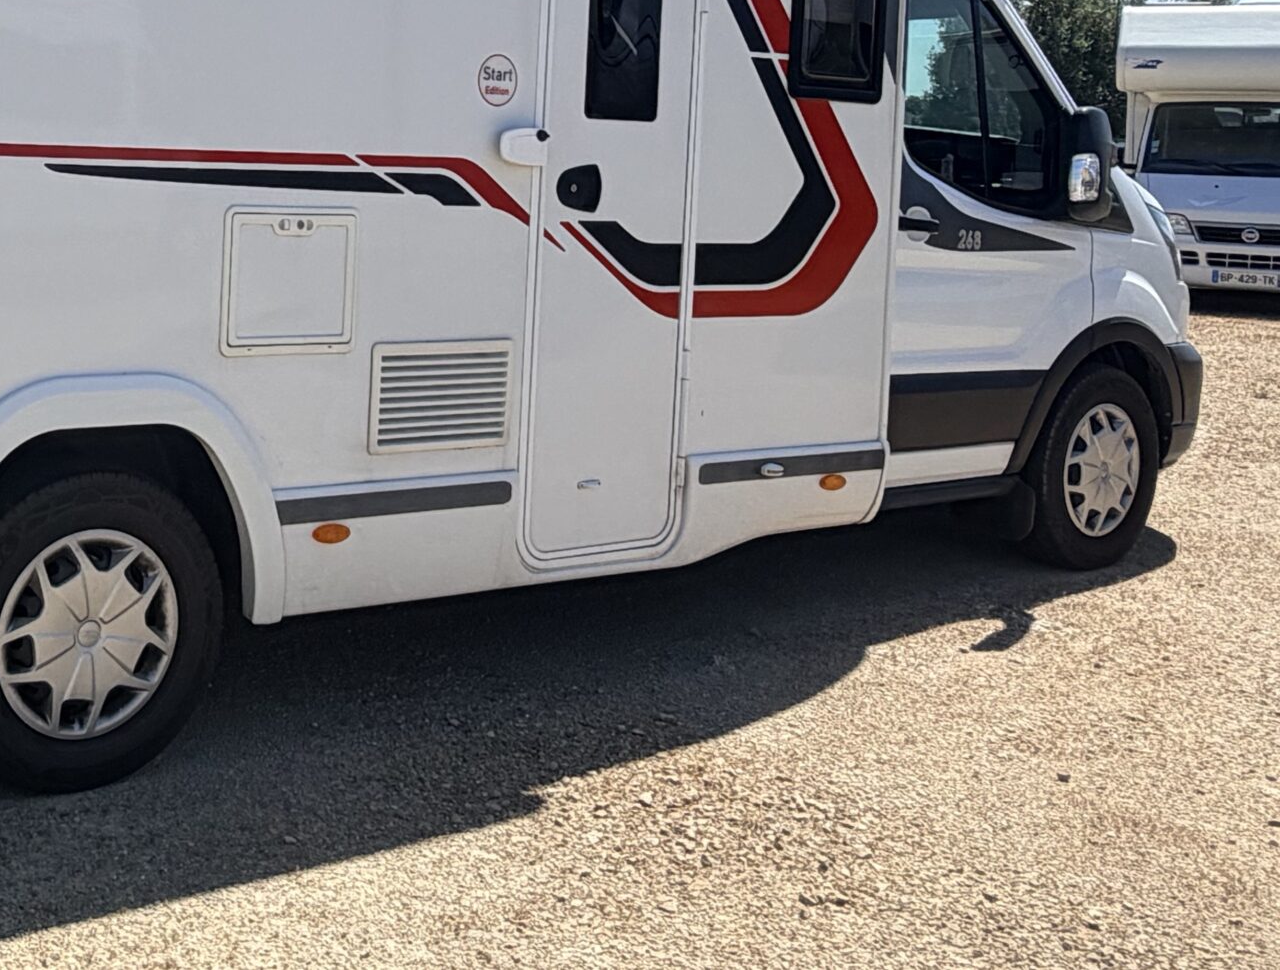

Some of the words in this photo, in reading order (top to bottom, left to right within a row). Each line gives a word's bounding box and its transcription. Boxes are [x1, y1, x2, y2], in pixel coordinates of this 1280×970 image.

[482, 65, 513, 82] Start
[485, 85, 509, 95] Edition
[957, 229, 982, 250] 268
